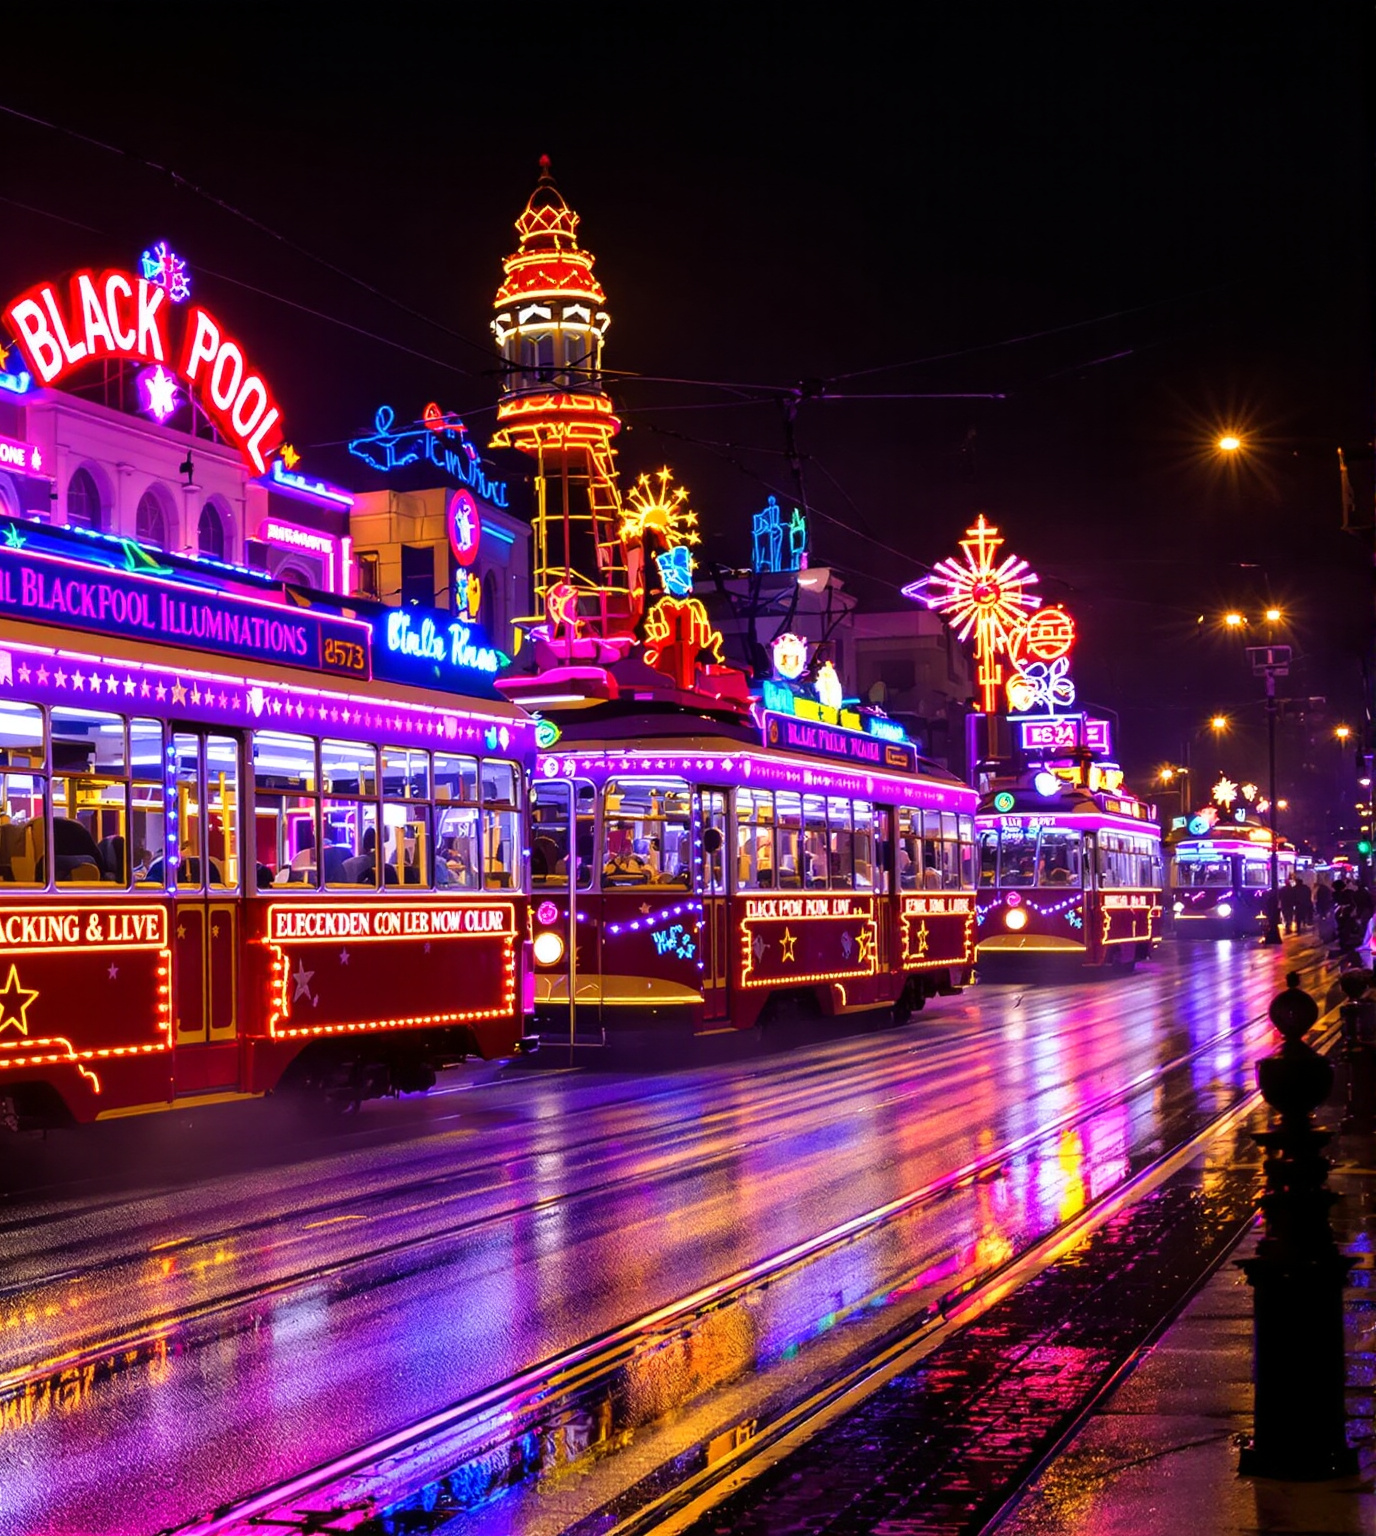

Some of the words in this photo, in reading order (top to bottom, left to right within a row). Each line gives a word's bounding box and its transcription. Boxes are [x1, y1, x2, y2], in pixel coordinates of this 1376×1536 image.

[11, 273, 165, 383] BLACK
[185, 309, 280, 475] POOL
[85, 913, 104, 942] &
